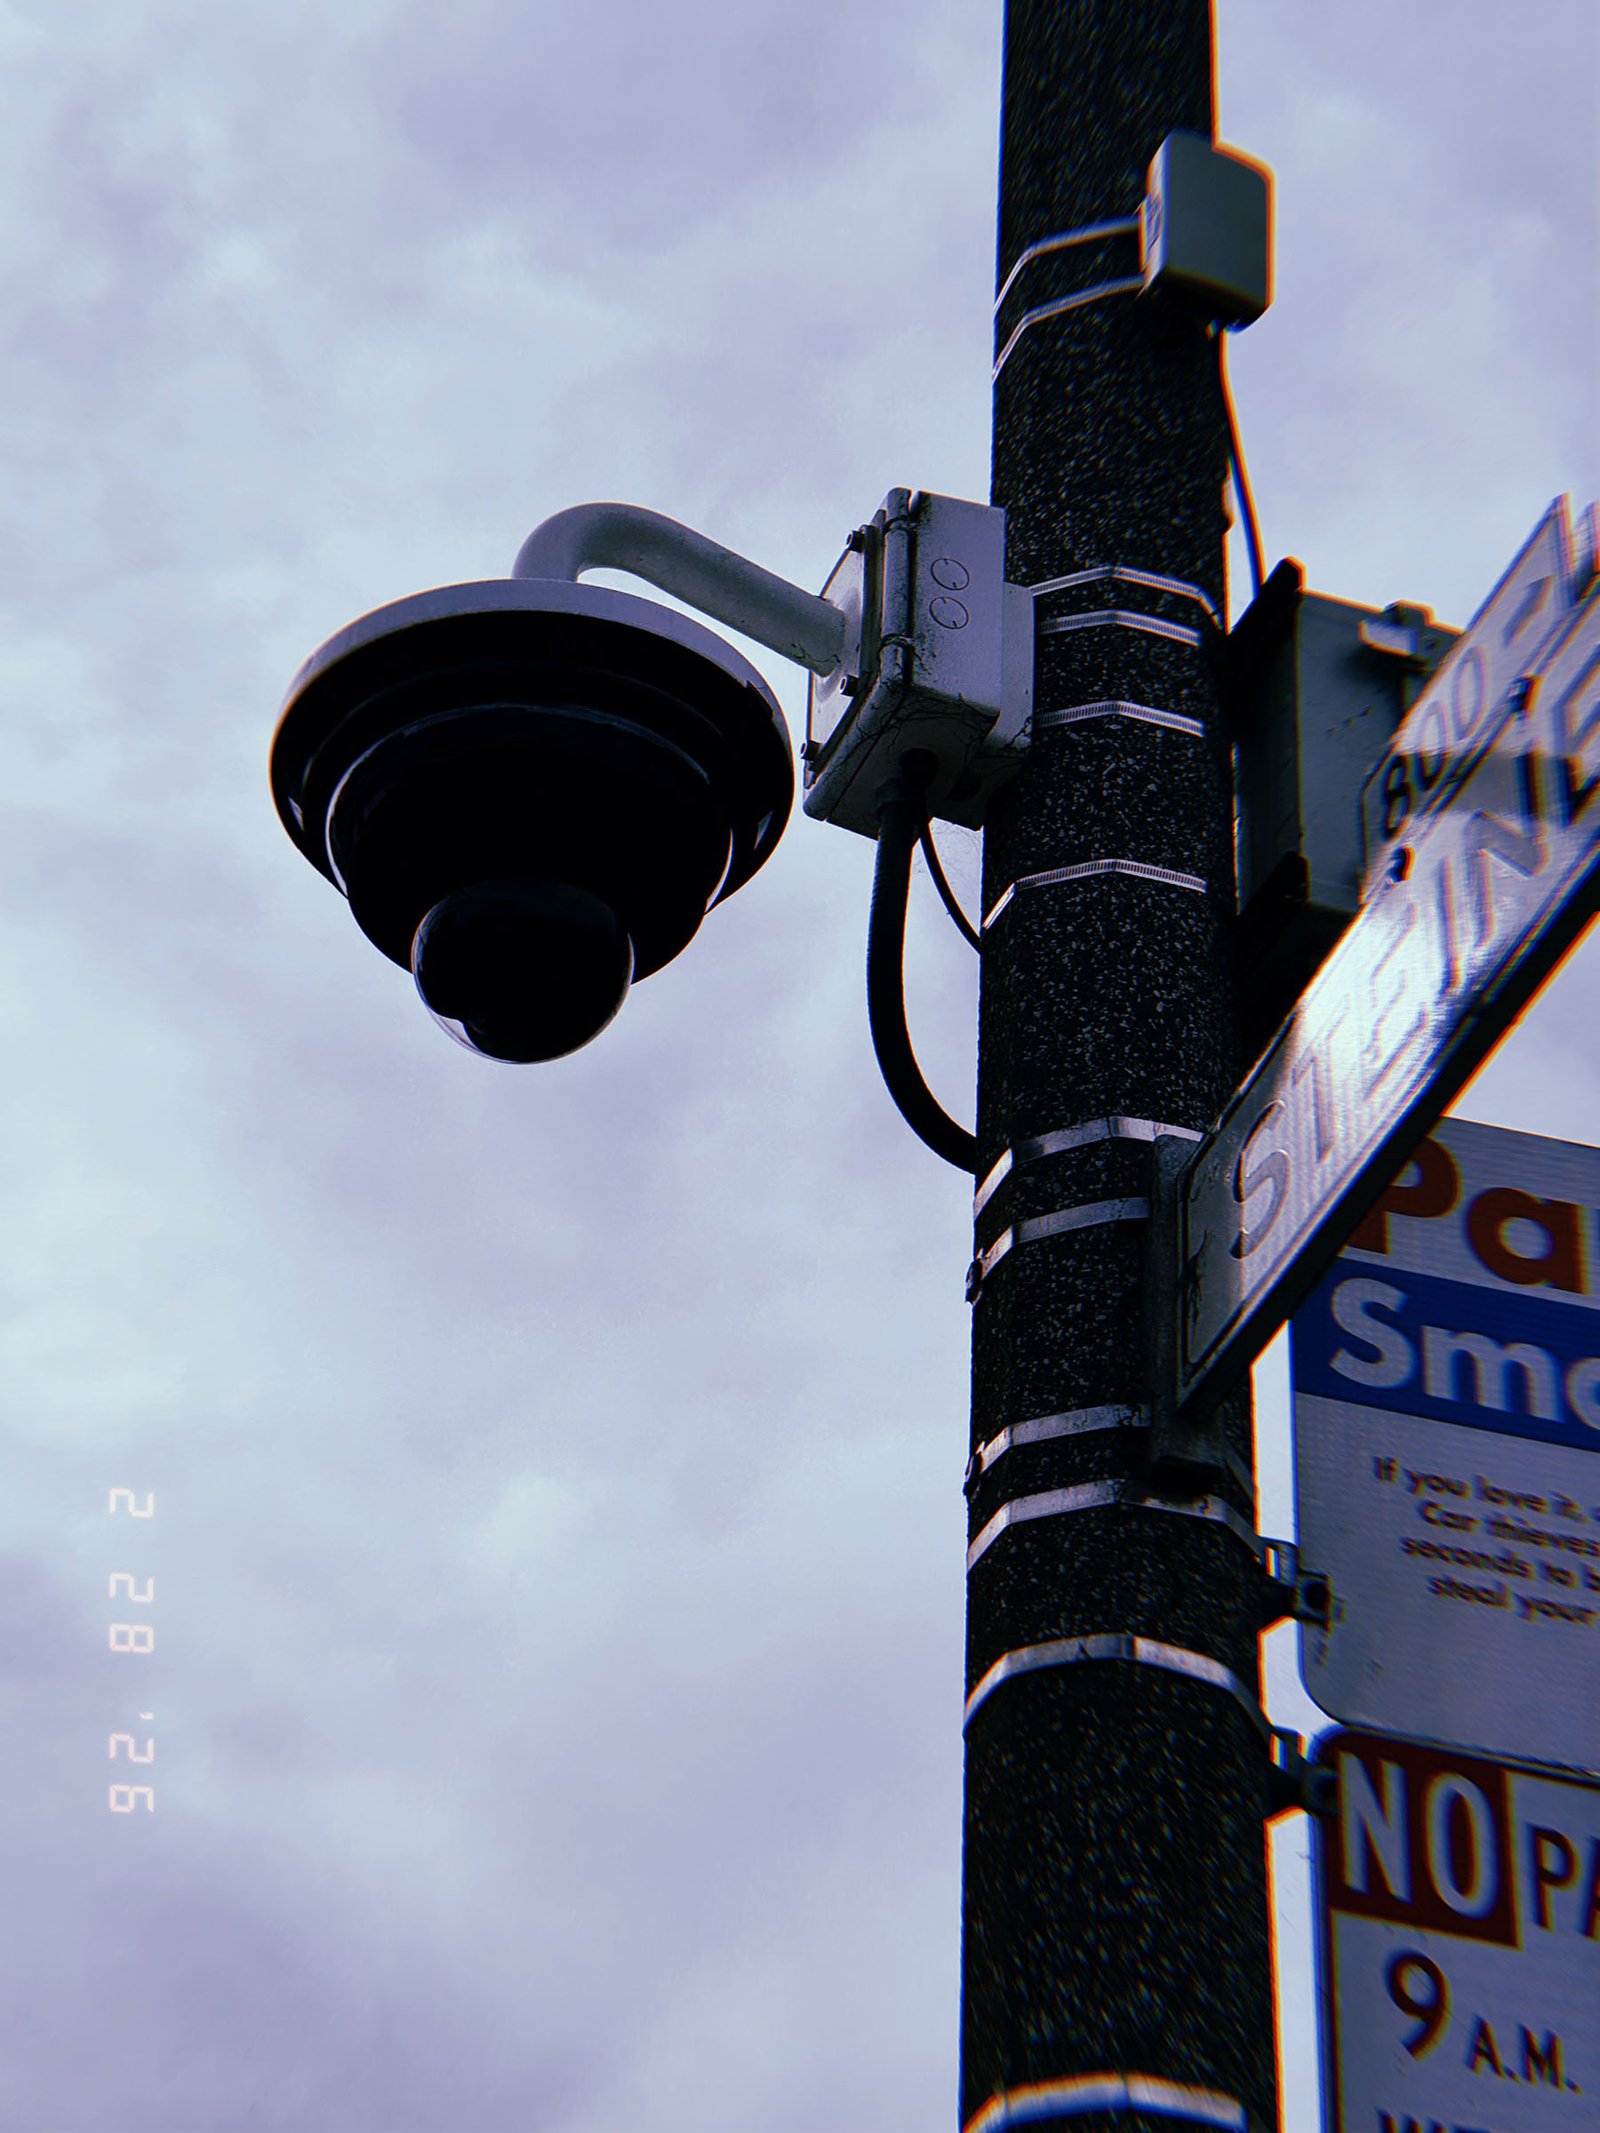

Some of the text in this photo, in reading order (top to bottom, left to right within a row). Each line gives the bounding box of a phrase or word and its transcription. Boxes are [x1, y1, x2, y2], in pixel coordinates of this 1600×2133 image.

[1382, 647, 1489, 842] 800
[1374, 1455, 1399, 1483] If
[1403, 1468, 1471, 1498] you
[1473, 1473, 1549, 1514] love
[1416, 1500, 1480, 1534] Car
[1484, 1511, 1600, 1559] thieves
[1399, 1536, 1536, 1581] seconds
[1537, 1559, 1579, 1588] to
[1426, 1573, 1599, 1625] steal your
[1338, 1750, 1498, 1920] NO
[1384, 1948, 1583, 2096] 9 A.M.
